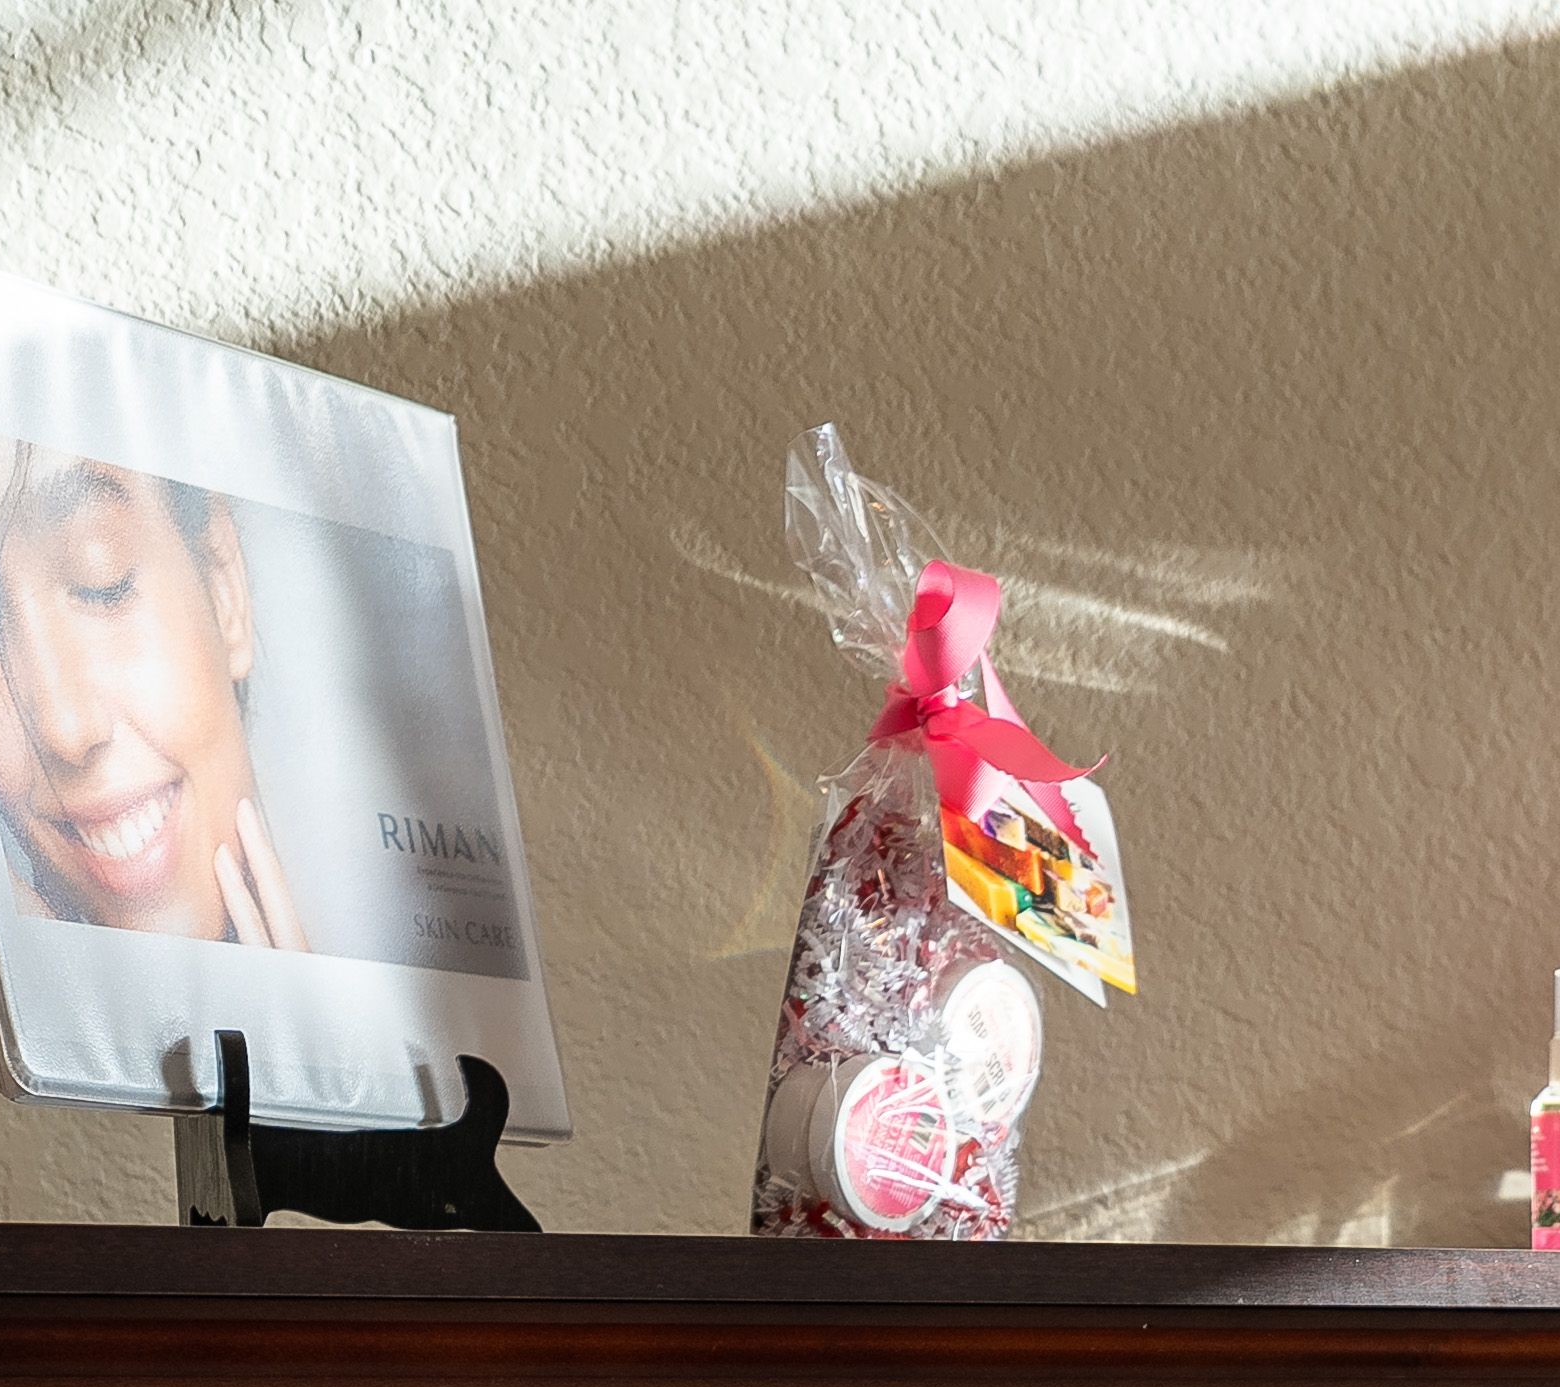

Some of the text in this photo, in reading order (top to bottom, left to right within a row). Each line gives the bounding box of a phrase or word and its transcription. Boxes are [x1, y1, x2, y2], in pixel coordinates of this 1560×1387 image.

[377, 812, 500, 866] RIMAN
[413, 913, 513, 949] SKIN CARE
